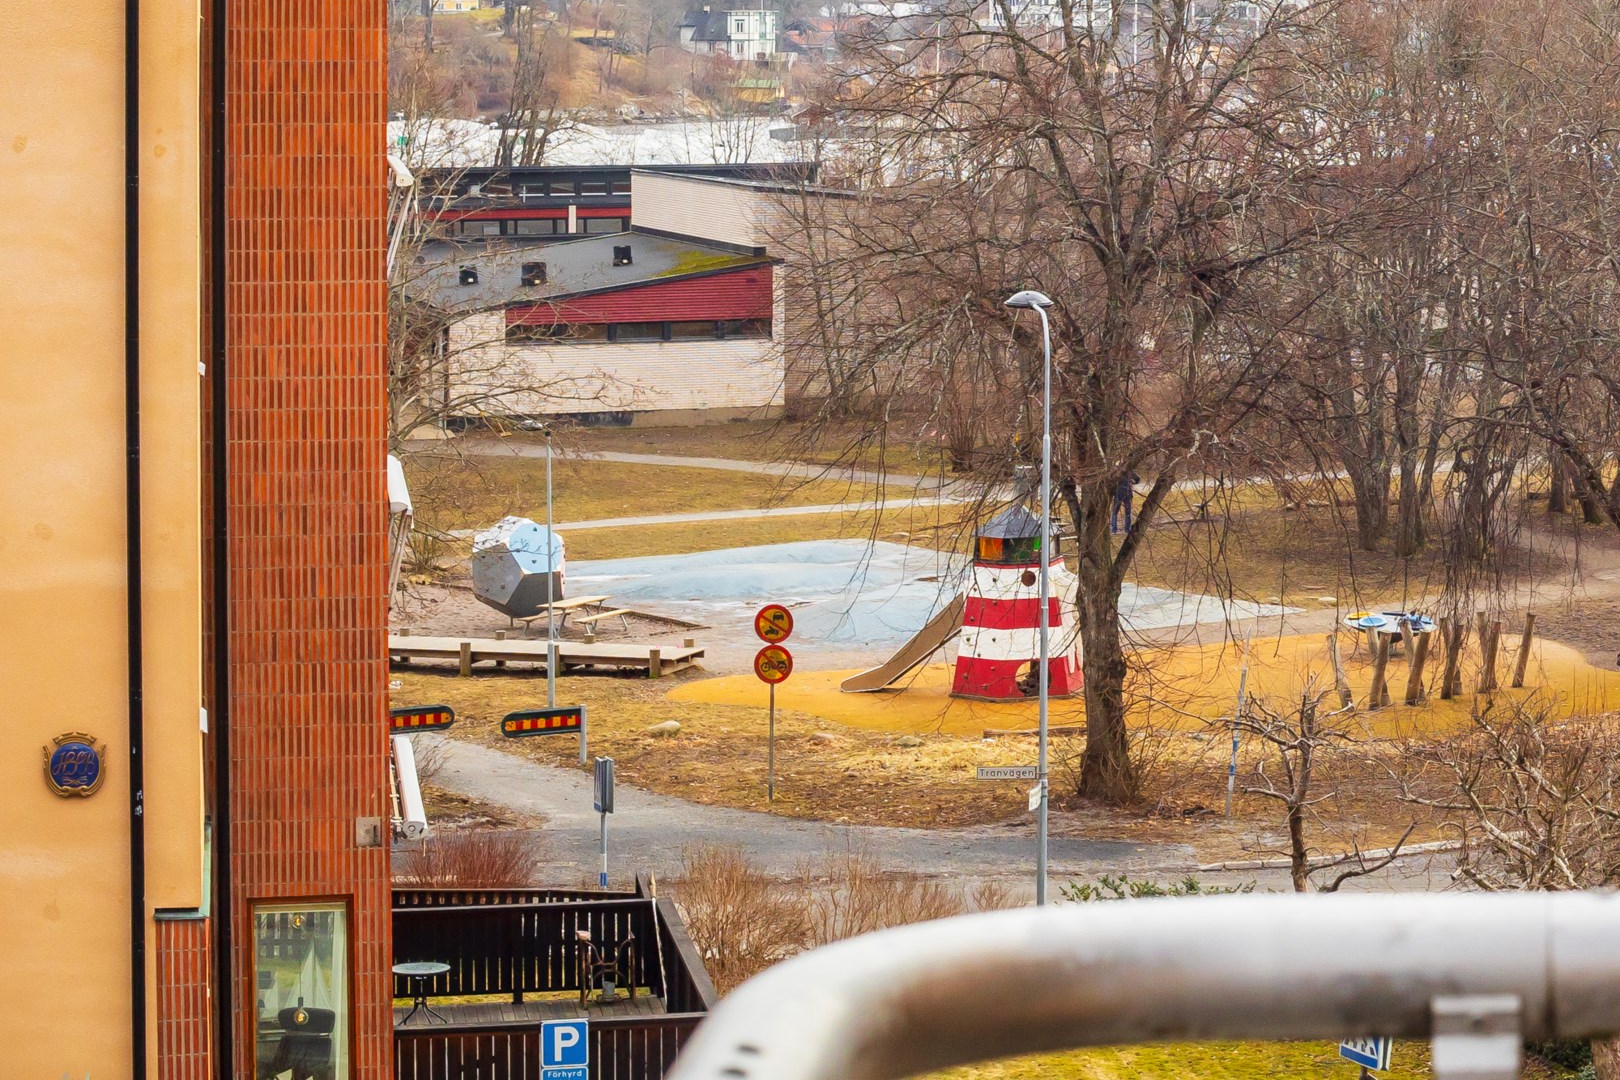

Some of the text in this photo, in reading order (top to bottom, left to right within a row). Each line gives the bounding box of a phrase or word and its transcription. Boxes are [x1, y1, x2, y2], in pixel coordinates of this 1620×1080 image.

[979, 768, 1034, 778] Tranvägen
[554, 1026, 580, 1062] P
[547, 1070, 583, 1079] Förhyrd
